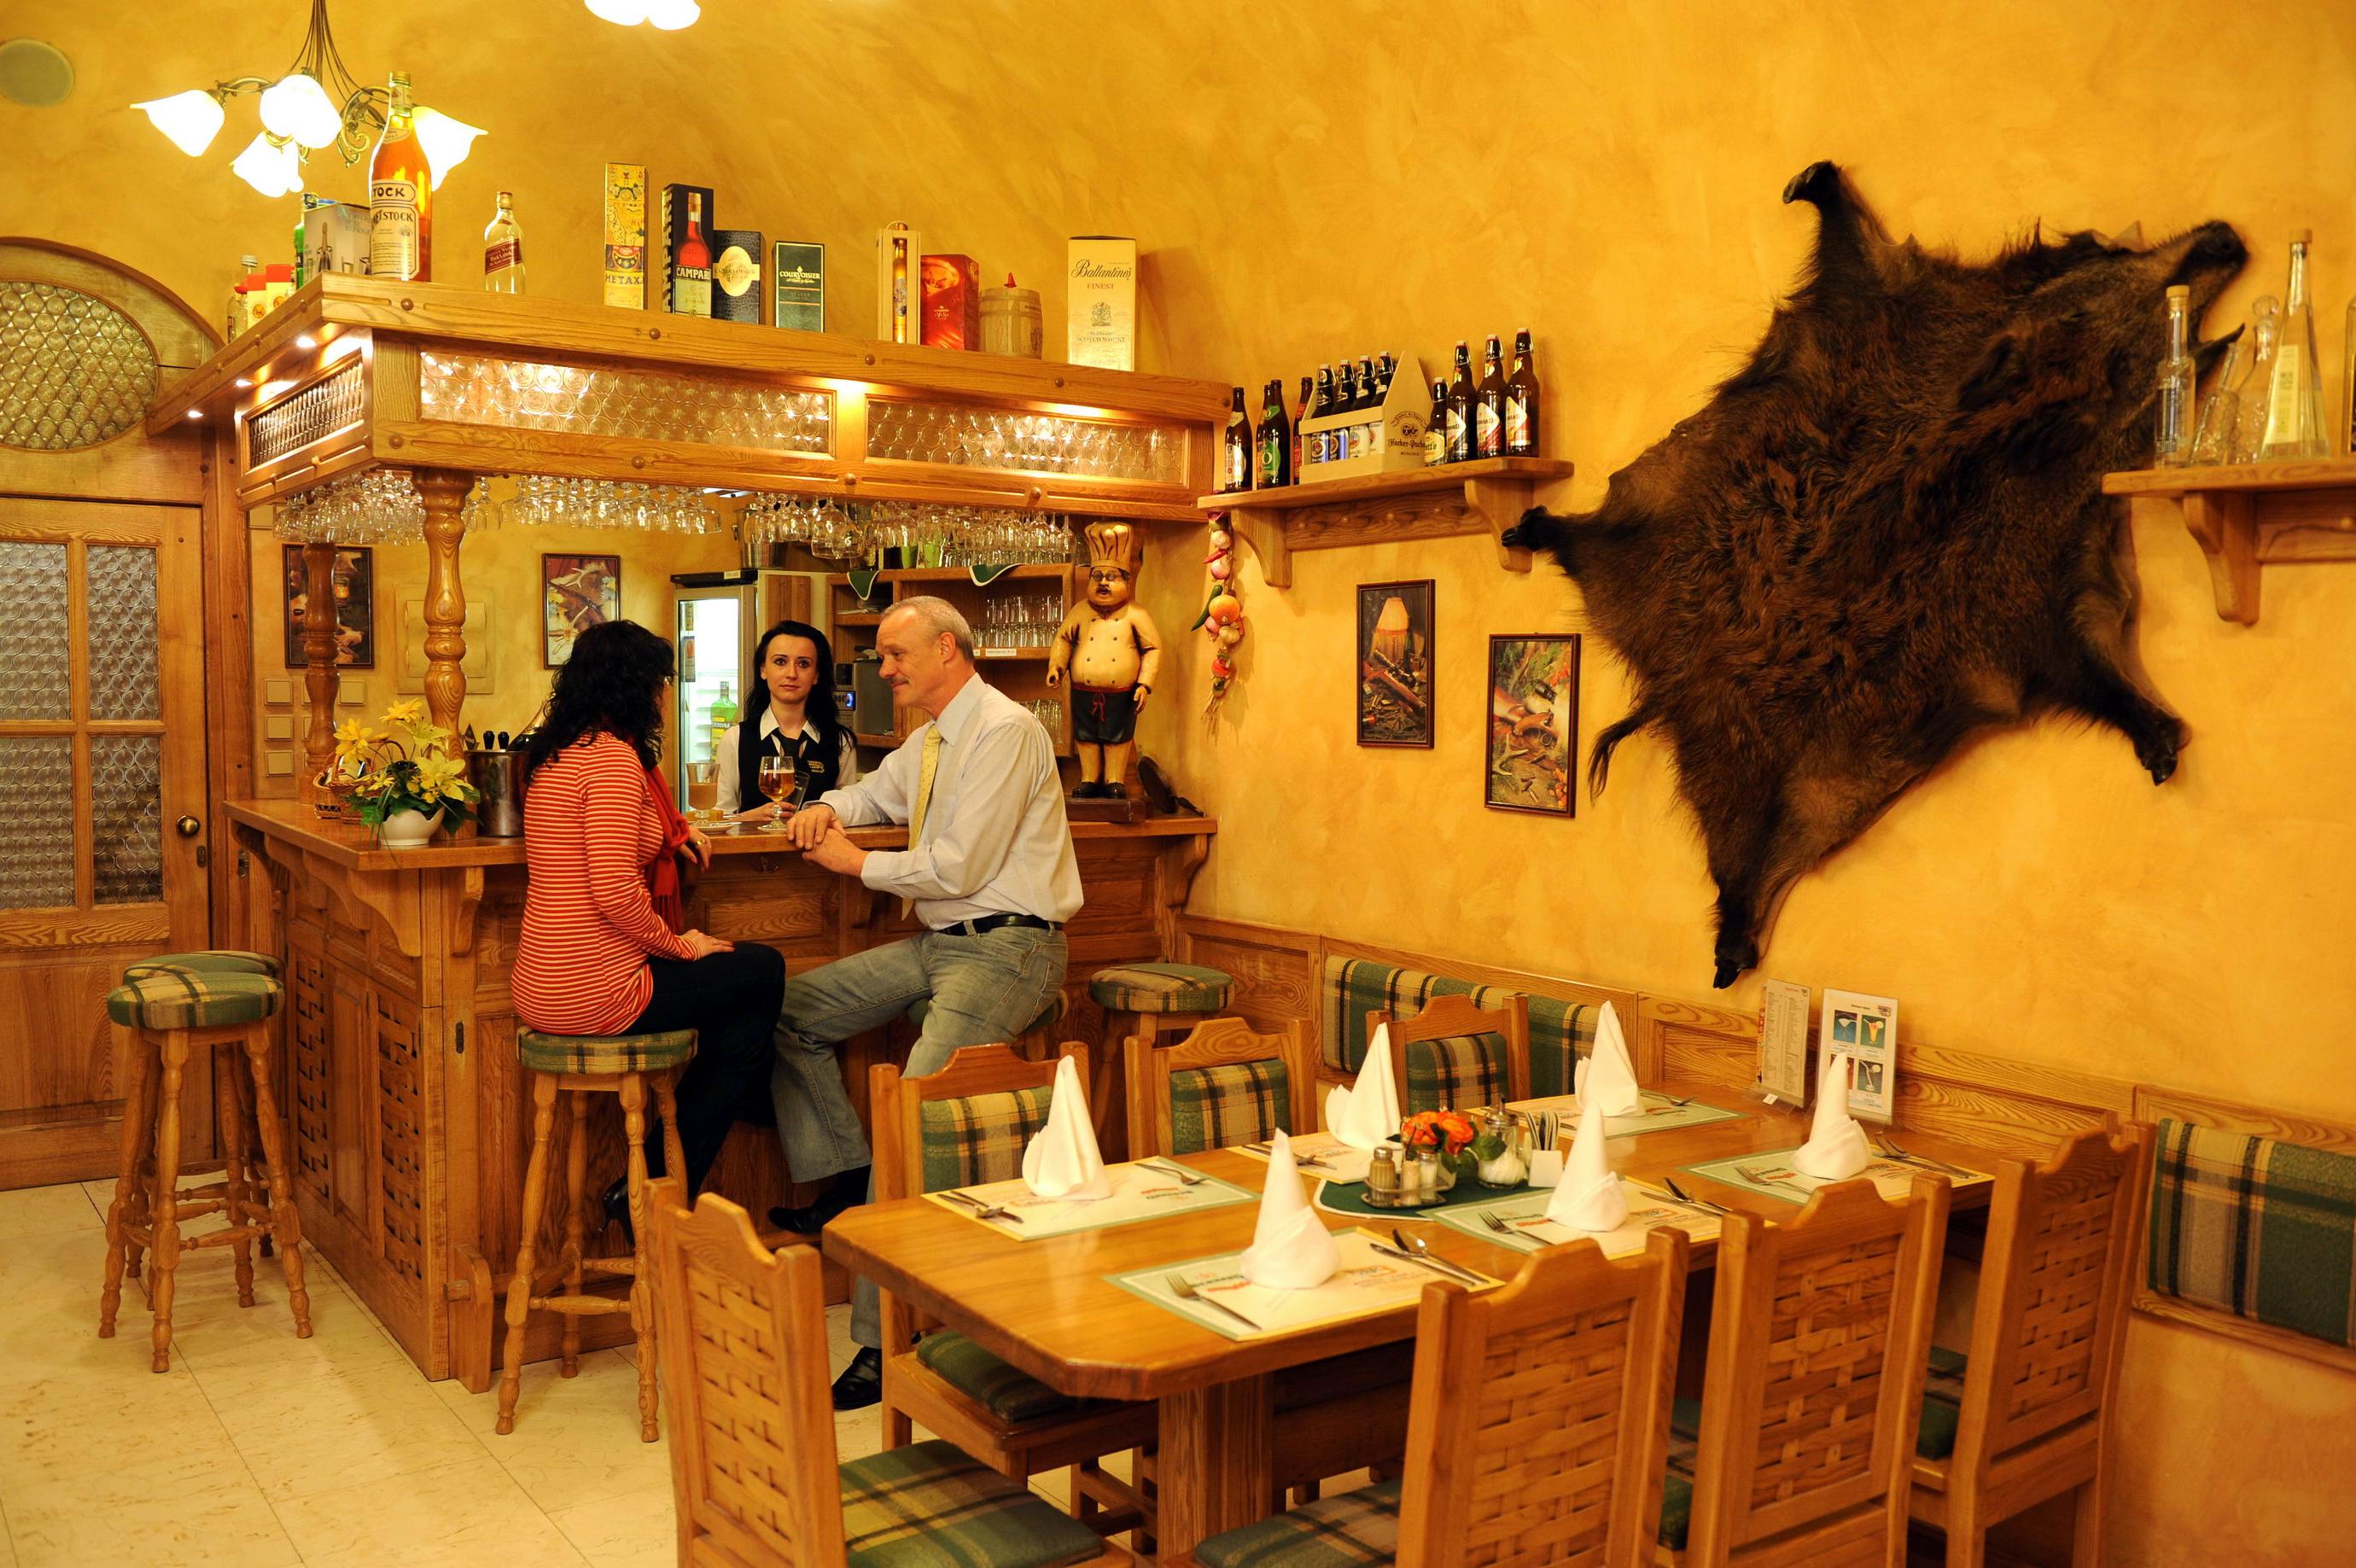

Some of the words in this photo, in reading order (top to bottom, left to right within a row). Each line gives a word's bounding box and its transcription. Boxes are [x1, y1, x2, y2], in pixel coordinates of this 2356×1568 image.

[373, 187, 405, 197] TOCK
[605, 273, 643, 284] METAX
[676, 267, 710, 280] CAMPARI
[779, 271, 820, 280] COURVOISIER
